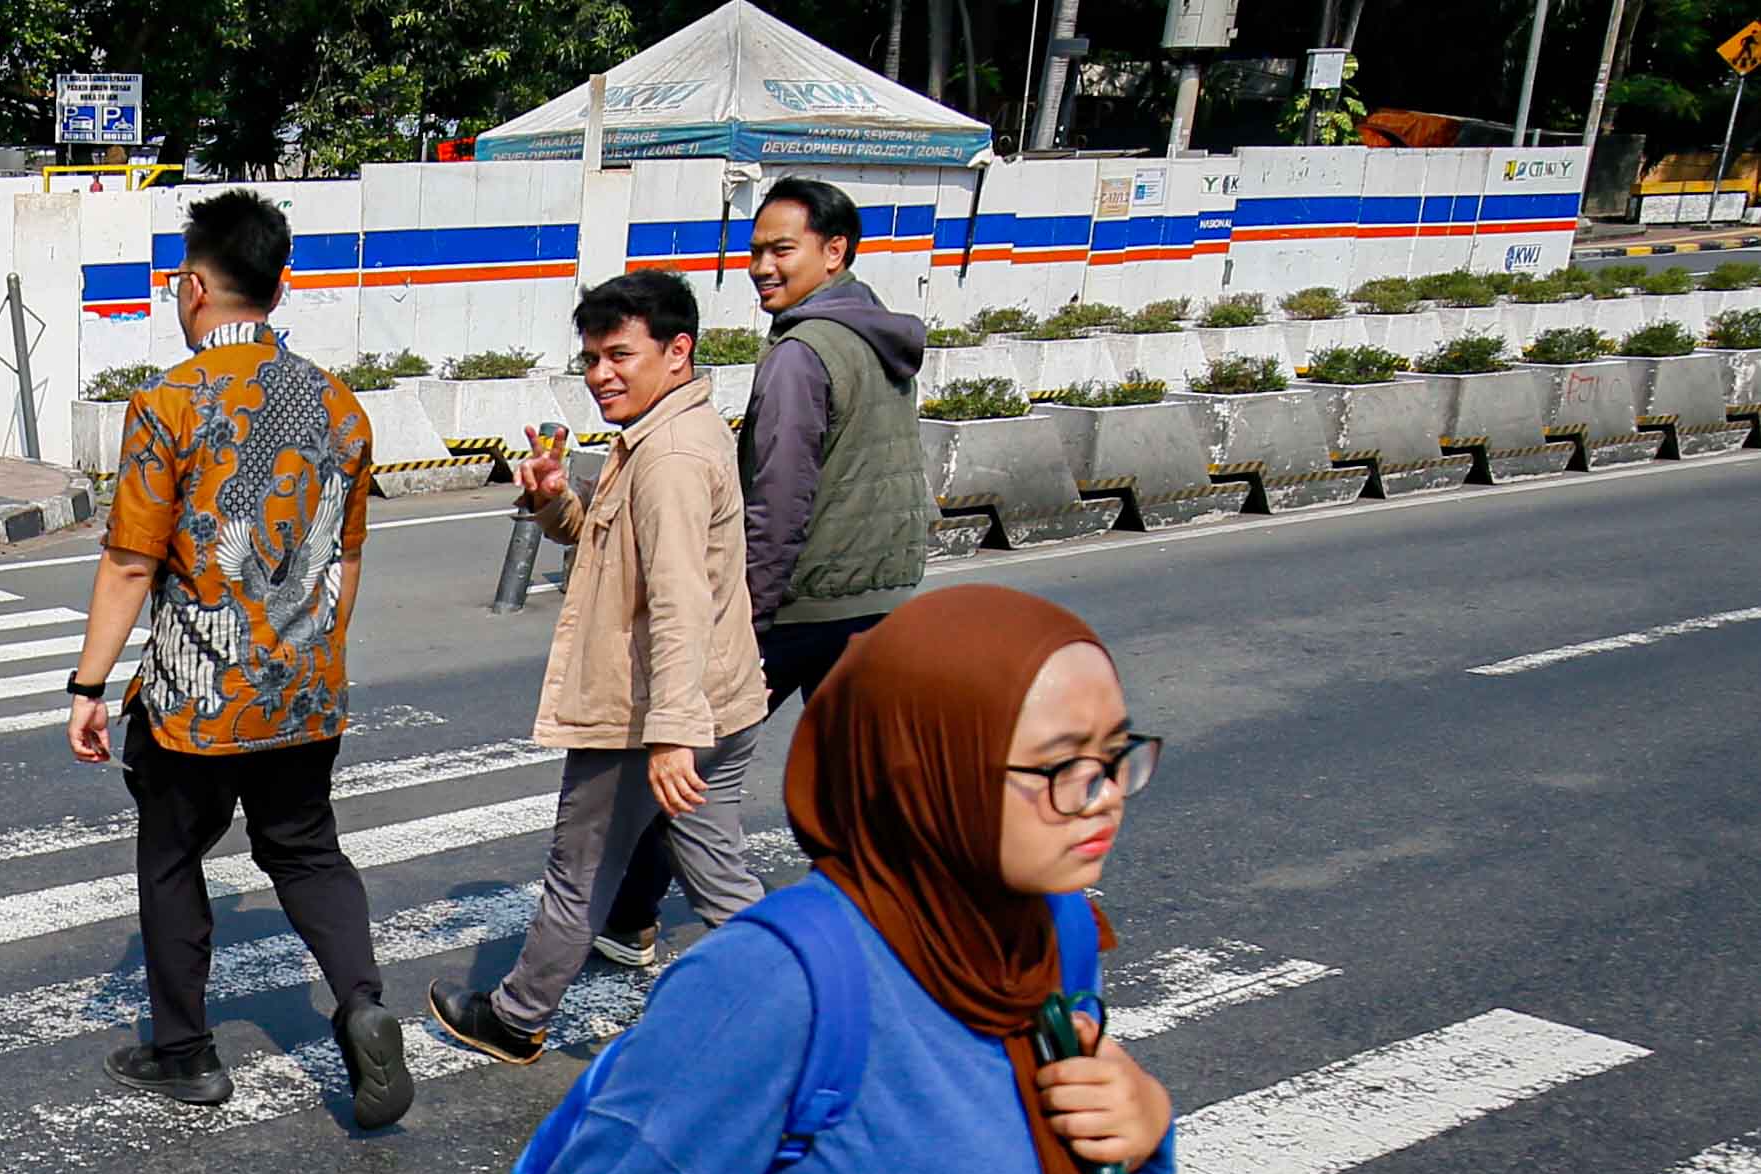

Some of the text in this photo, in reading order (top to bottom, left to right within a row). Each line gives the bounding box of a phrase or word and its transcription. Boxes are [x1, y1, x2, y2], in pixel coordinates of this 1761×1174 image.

[63, 106, 78, 123] P
[103, 107, 122, 127] P
[103, 132, 134, 140] MOTOR
[529, 131, 659, 149] JAKARTA WERAGE
[808, 128, 931, 143] JAKARTA SEWERAGE
[493, 148, 582, 160] DEVELOPMENT
[602, 145, 644, 158] JECT
[644, 143, 688, 157] (ZONE
[762, 142, 854, 155] DEVELOPMENT
[856, 143, 912, 157] PROJECT
[914, 145, 953, 158] (ZONE
[1199, 219, 1232, 230] NASIONAL
[1514, 247, 1542, 264] KWJ
